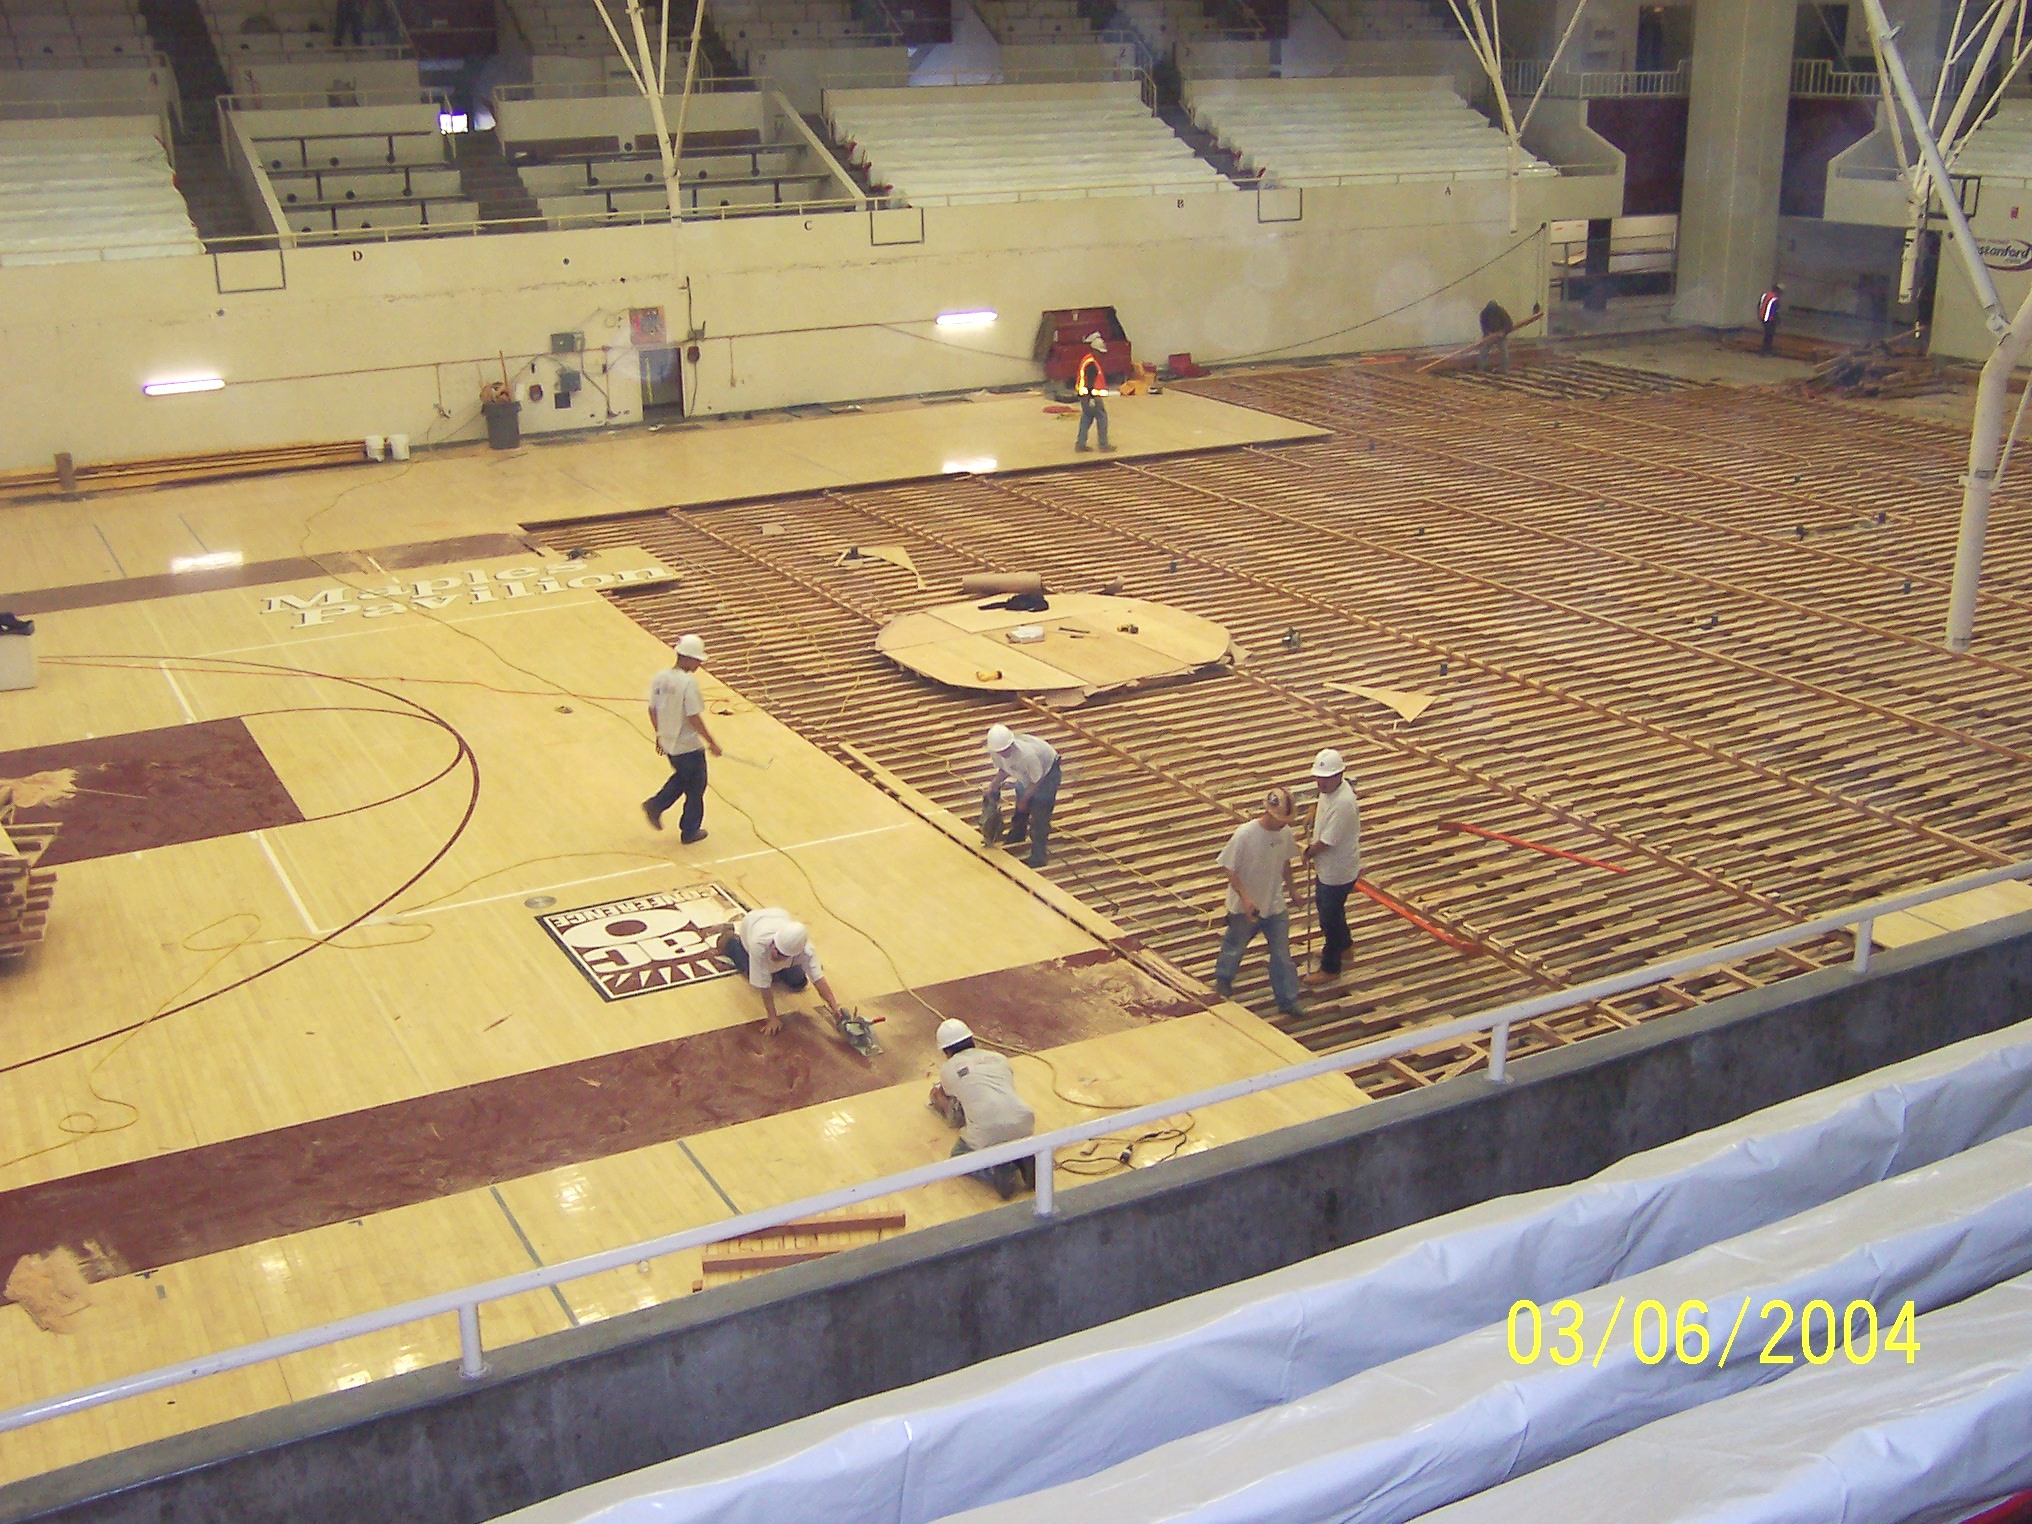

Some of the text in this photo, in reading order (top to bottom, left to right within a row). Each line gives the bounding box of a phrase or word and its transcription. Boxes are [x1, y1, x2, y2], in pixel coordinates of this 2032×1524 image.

[1177, 199, 1185, 209] B
[804, 220, 814, 231] C
[352, 250, 363, 261] D
[260, 559, 589, 615] Maples
[291, 567, 670, 629] Pavilion
